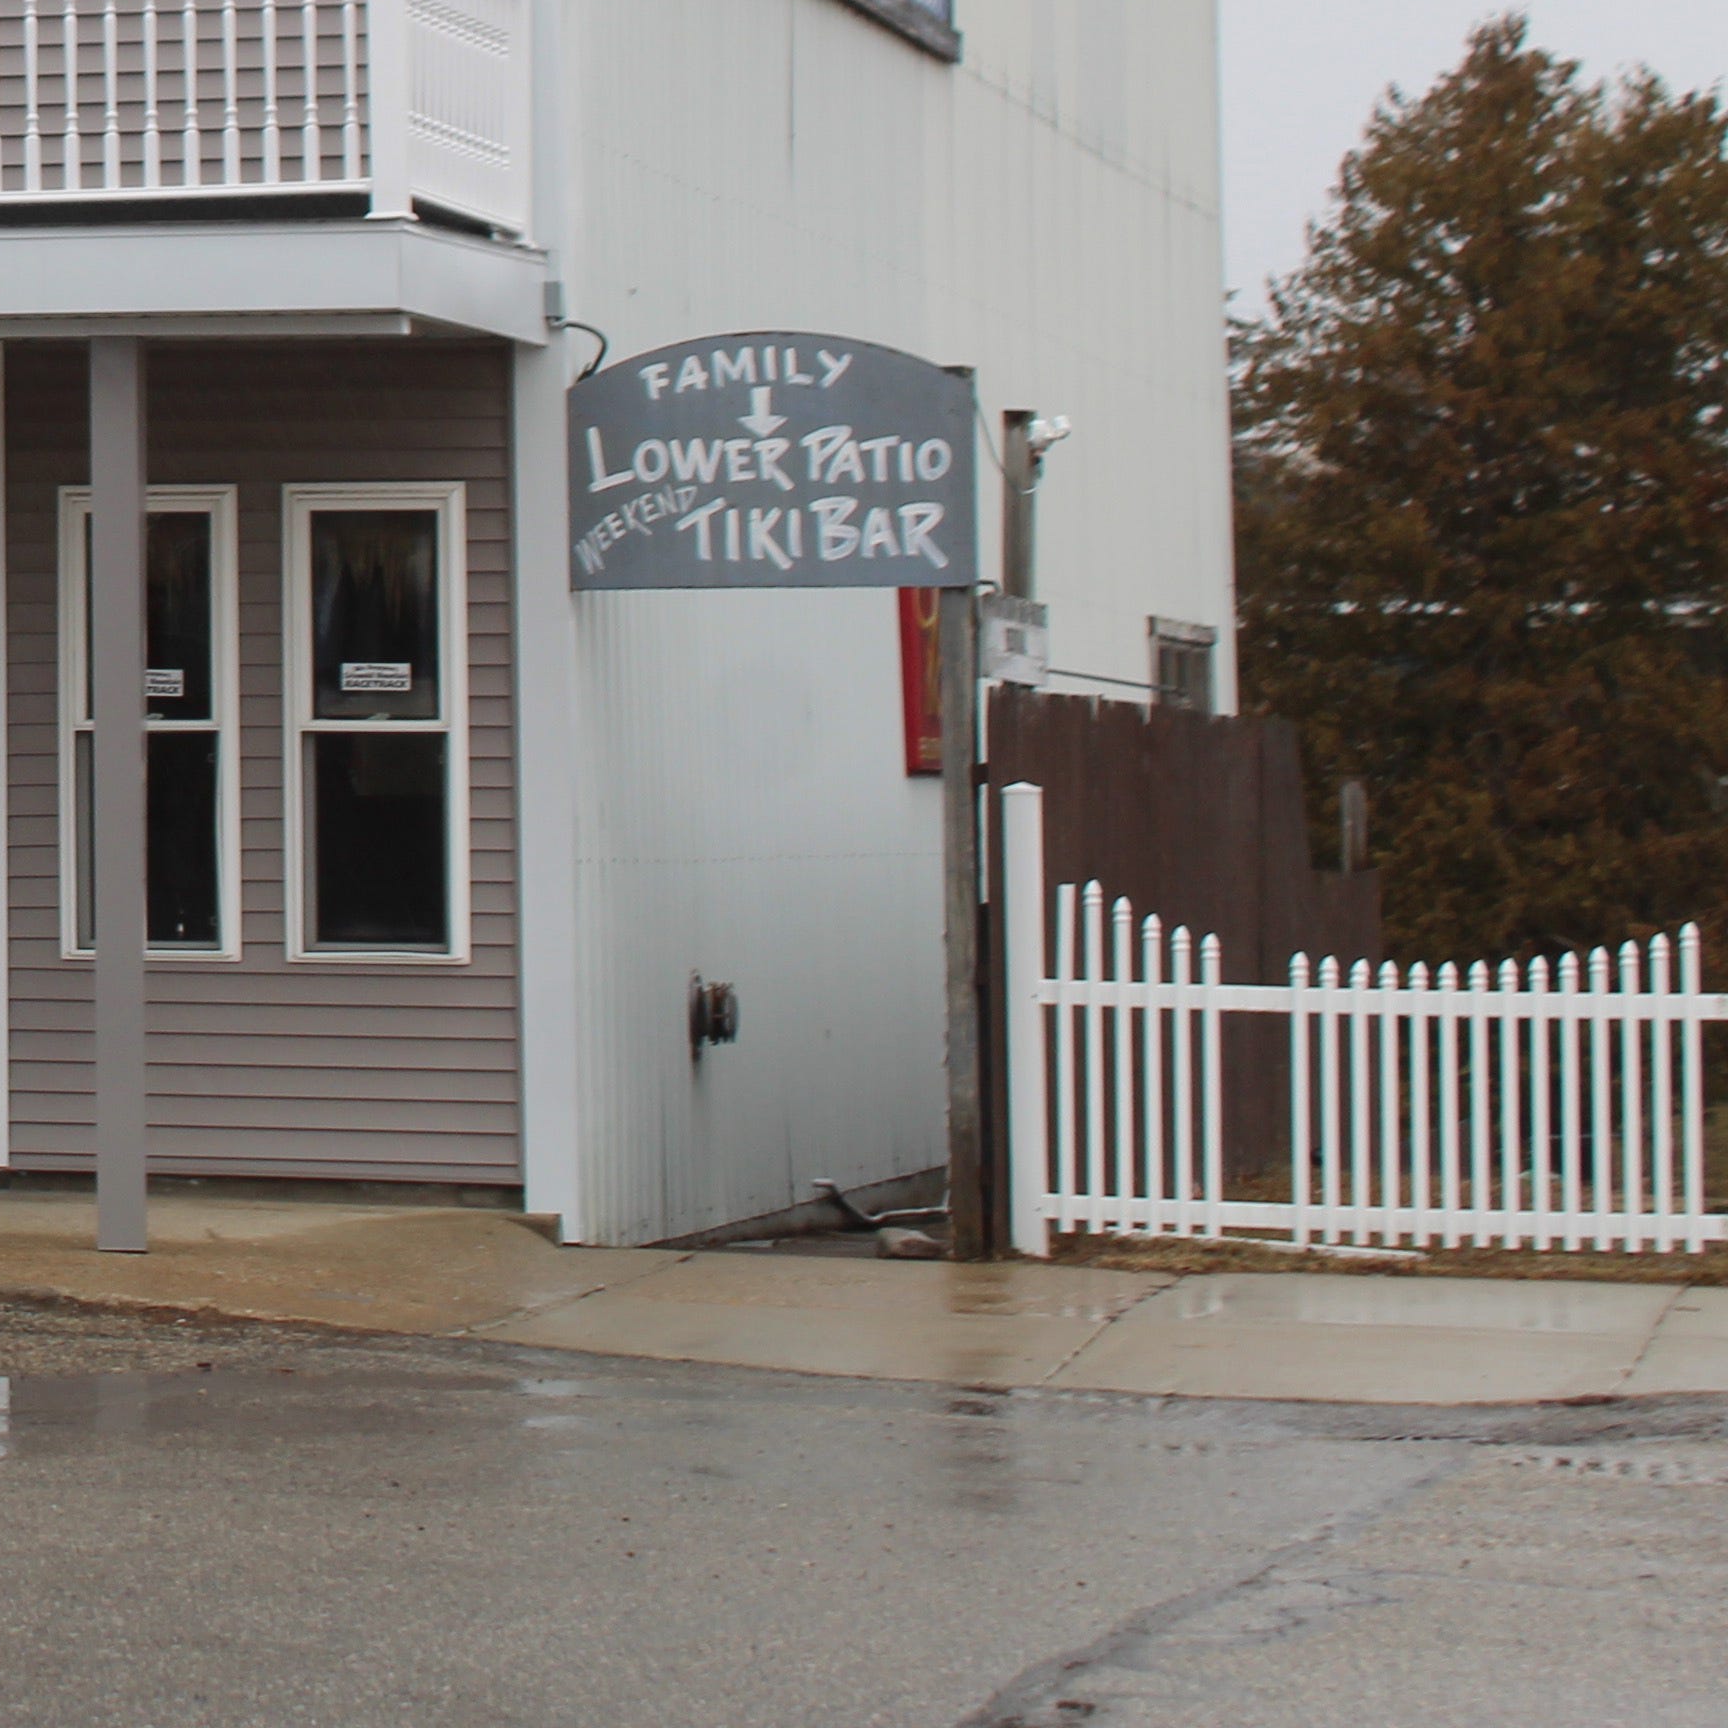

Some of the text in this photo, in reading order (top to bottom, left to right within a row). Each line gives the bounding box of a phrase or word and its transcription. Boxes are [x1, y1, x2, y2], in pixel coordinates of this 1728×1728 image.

[637, 344, 853, 400] FAMILY
[587, 424, 953, 493] LOWER PATIO
[573, 484, 949, 575] WEEKEND TIKI BAR
